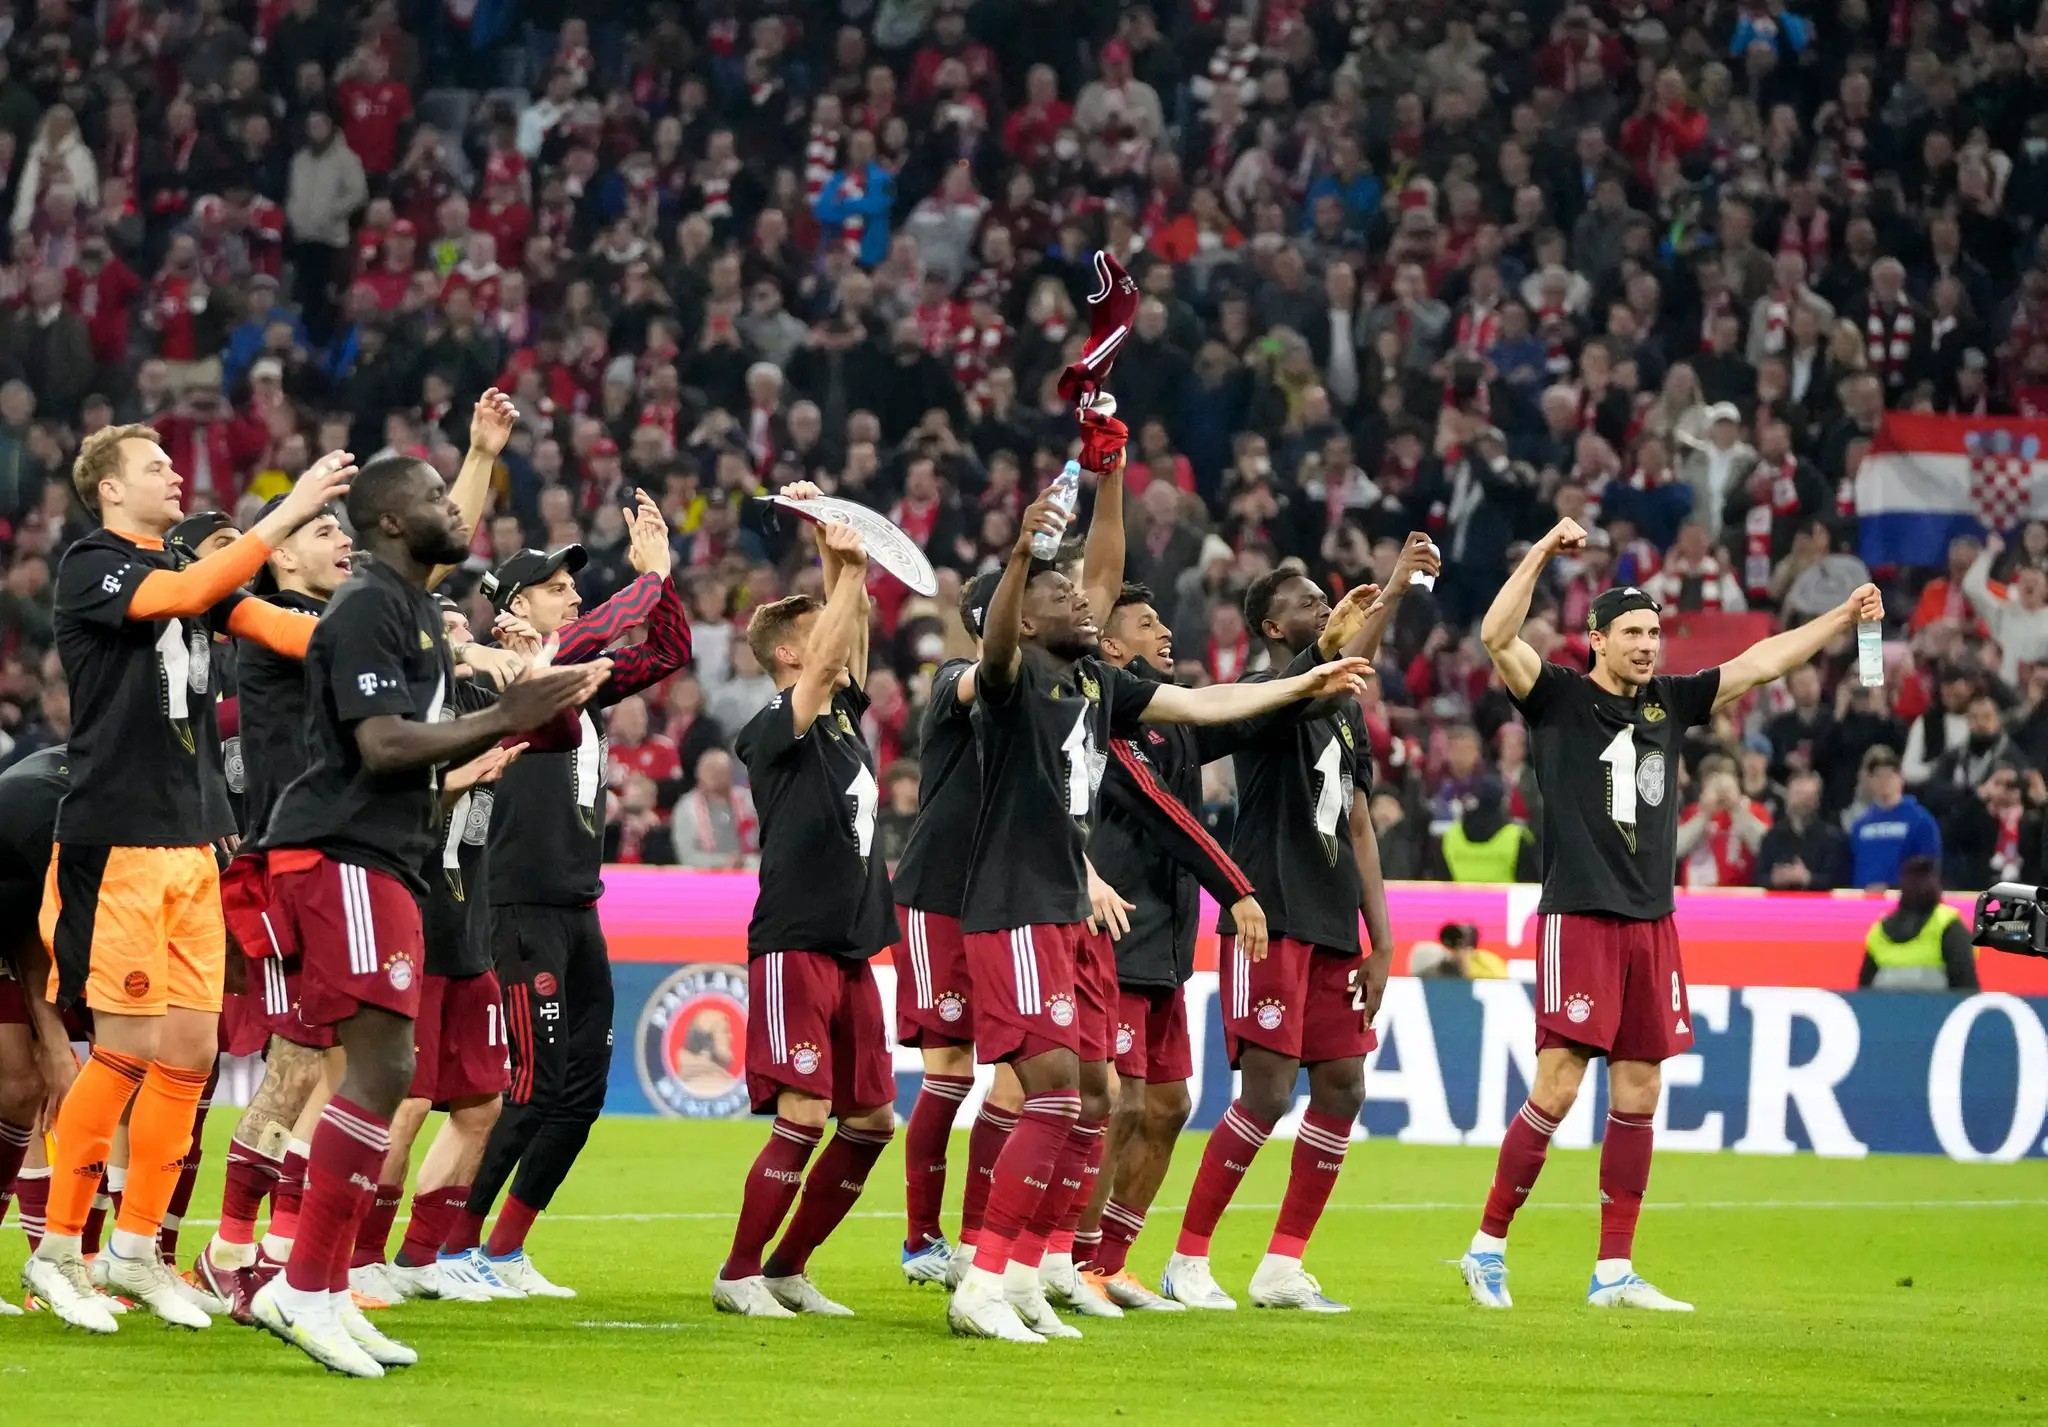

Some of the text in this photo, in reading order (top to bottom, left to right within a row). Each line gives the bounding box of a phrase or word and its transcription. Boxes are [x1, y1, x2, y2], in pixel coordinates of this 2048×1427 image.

[1599, 723, 1637, 824] 1
[1671, 971, 1681, 1012] 8
[1928, 991, 2048, 1164] O
[764, 1168, 801, 1184] BAYER
[1224, 1159, 1248, 1173] BAY
